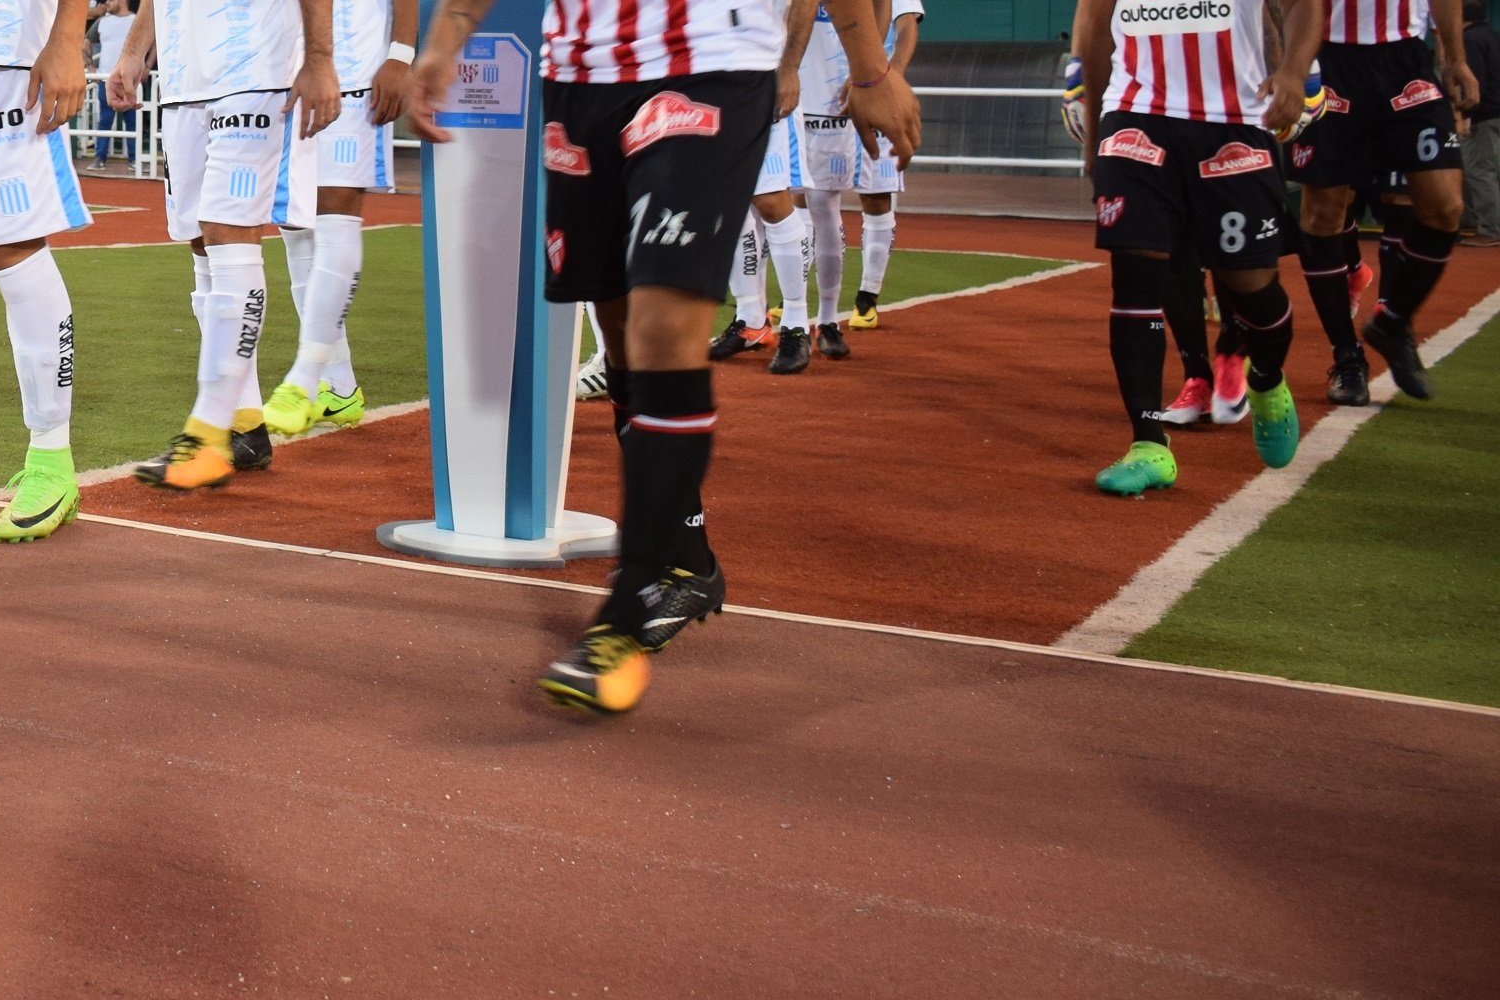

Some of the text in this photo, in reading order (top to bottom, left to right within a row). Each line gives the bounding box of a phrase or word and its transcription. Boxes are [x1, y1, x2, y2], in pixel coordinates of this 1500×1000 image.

[1120, 0, 1231, 23] autocrédito
[210, 113, 271, 131] MATO
[805, 118, 848, 130] MATO
[1417, 127, 1440, 162] 6
[1209, 153, 1264, 173] BLANGINO
[1220, 211, 1247, 253] 8
[237, 288, 266, 361] SPORT 2000
